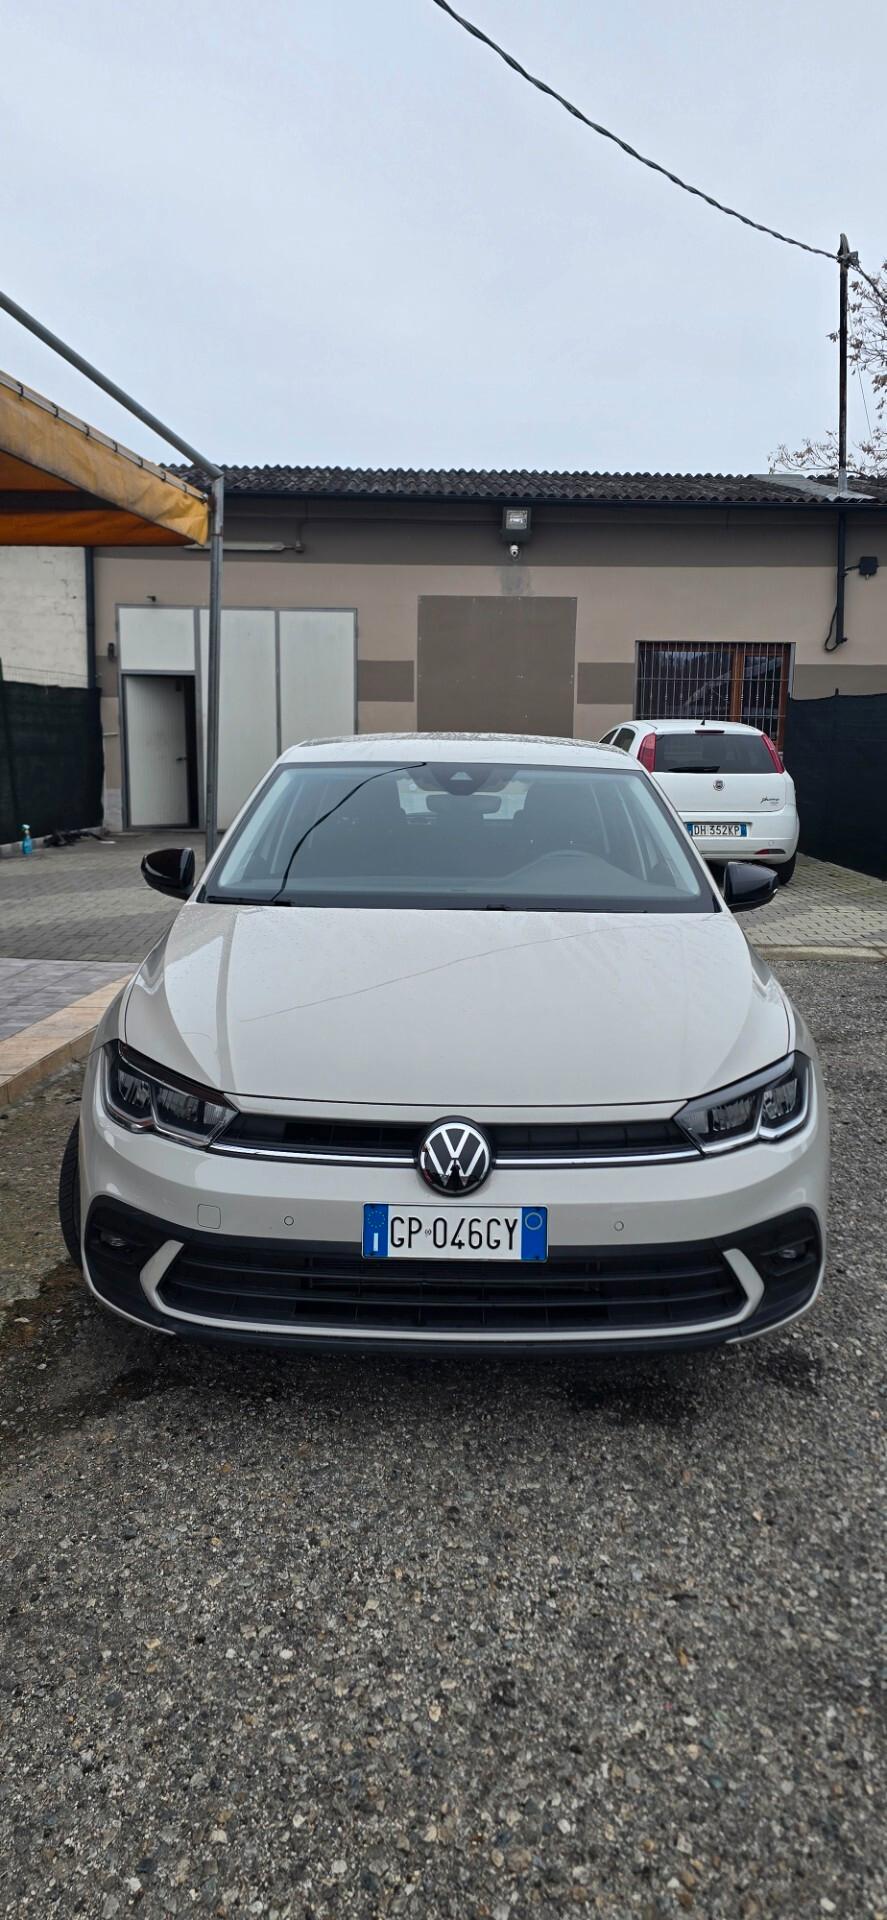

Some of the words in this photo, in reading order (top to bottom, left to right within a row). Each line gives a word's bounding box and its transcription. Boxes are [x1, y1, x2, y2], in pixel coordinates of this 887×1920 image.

[694, 825, 706, 835] DH
[710, 825, 740, 836] 352KP
[424, 1122, 486, 1187] VW
[390, 1216, 423, 1249] GP
[432, 1217, 519, 1251] 046GY
